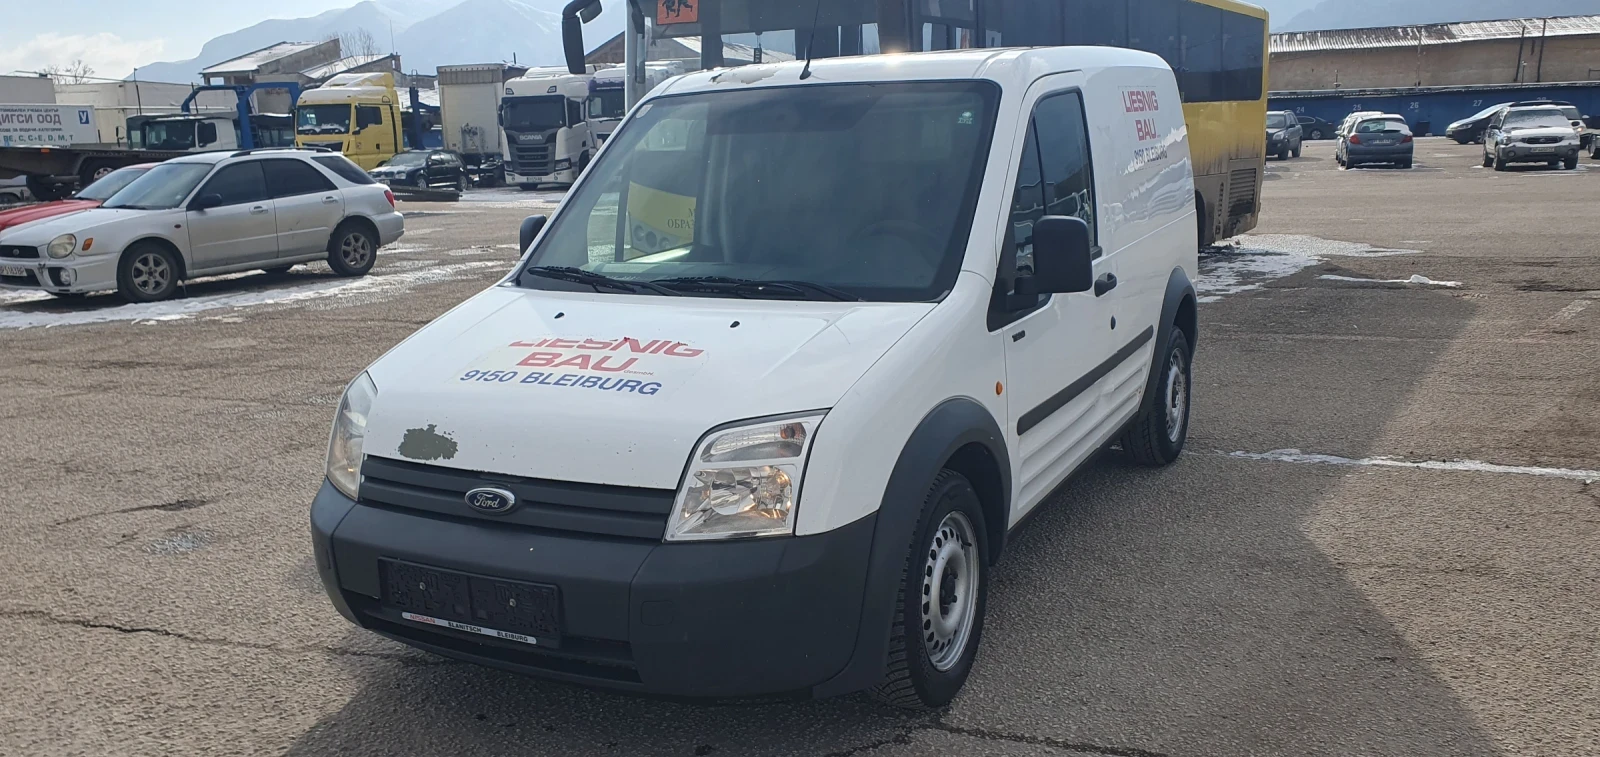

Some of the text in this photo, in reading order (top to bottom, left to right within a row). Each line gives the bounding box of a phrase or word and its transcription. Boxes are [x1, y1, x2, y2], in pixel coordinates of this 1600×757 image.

[1122, 90, 1159, 112] LIESNIG
[1409, 101, 1419, 109] 26
[1473, 99, 1482, 107] 27
[36, 113, 62, 125] ООД
[1135, 118, 1157, 141] BAU
[516, 351, 639, 372] BAU
[459, 369, 662, 395] 9150 BLEIBURG
[474, 492, 500, 508] Ford
[409, 613, 436, 624] NISSAN
[496, 631, 529, 642] BLEIBURG
